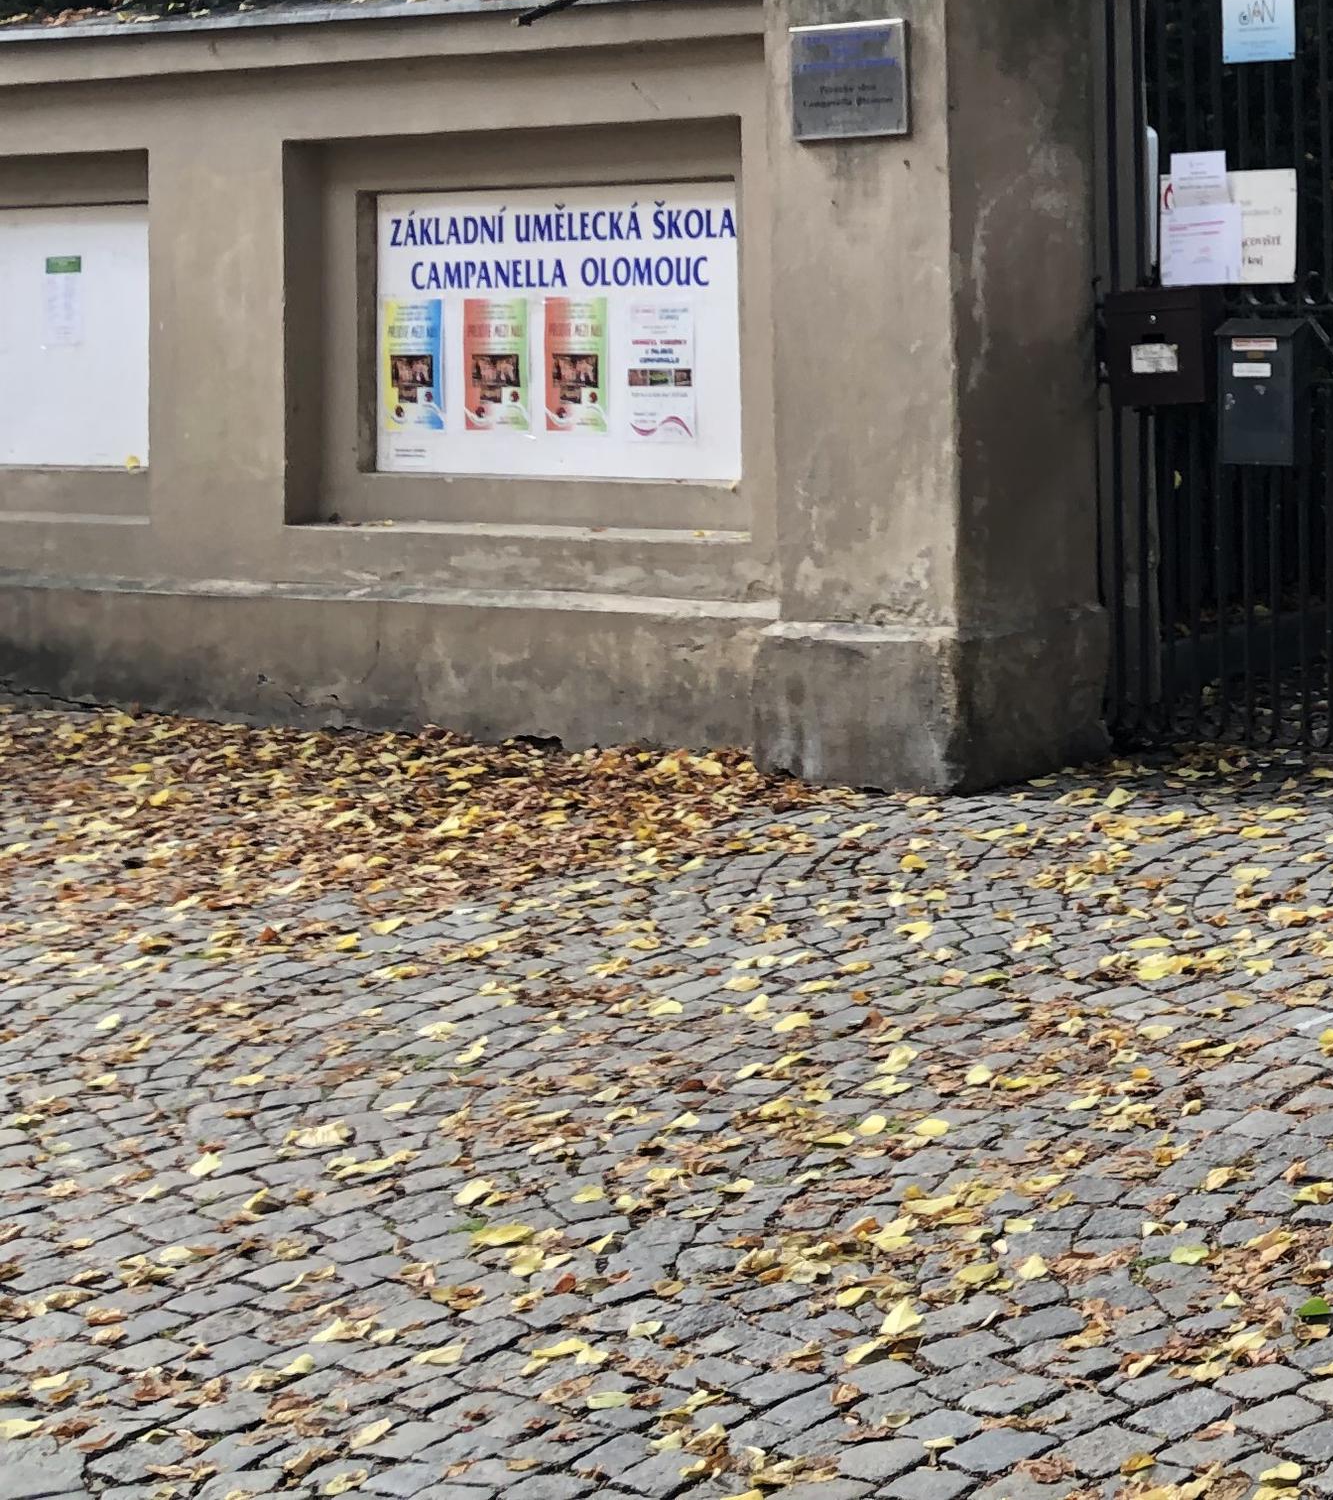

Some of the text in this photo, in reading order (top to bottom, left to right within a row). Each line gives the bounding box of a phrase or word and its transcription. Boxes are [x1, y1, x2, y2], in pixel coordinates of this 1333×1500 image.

[390, 200, 736, 247] ZÁKLADNÍ UMĚLECKÁ ŠKOLA
[411, 256, 710, 290] CAMPANELLA OLOMOUC
